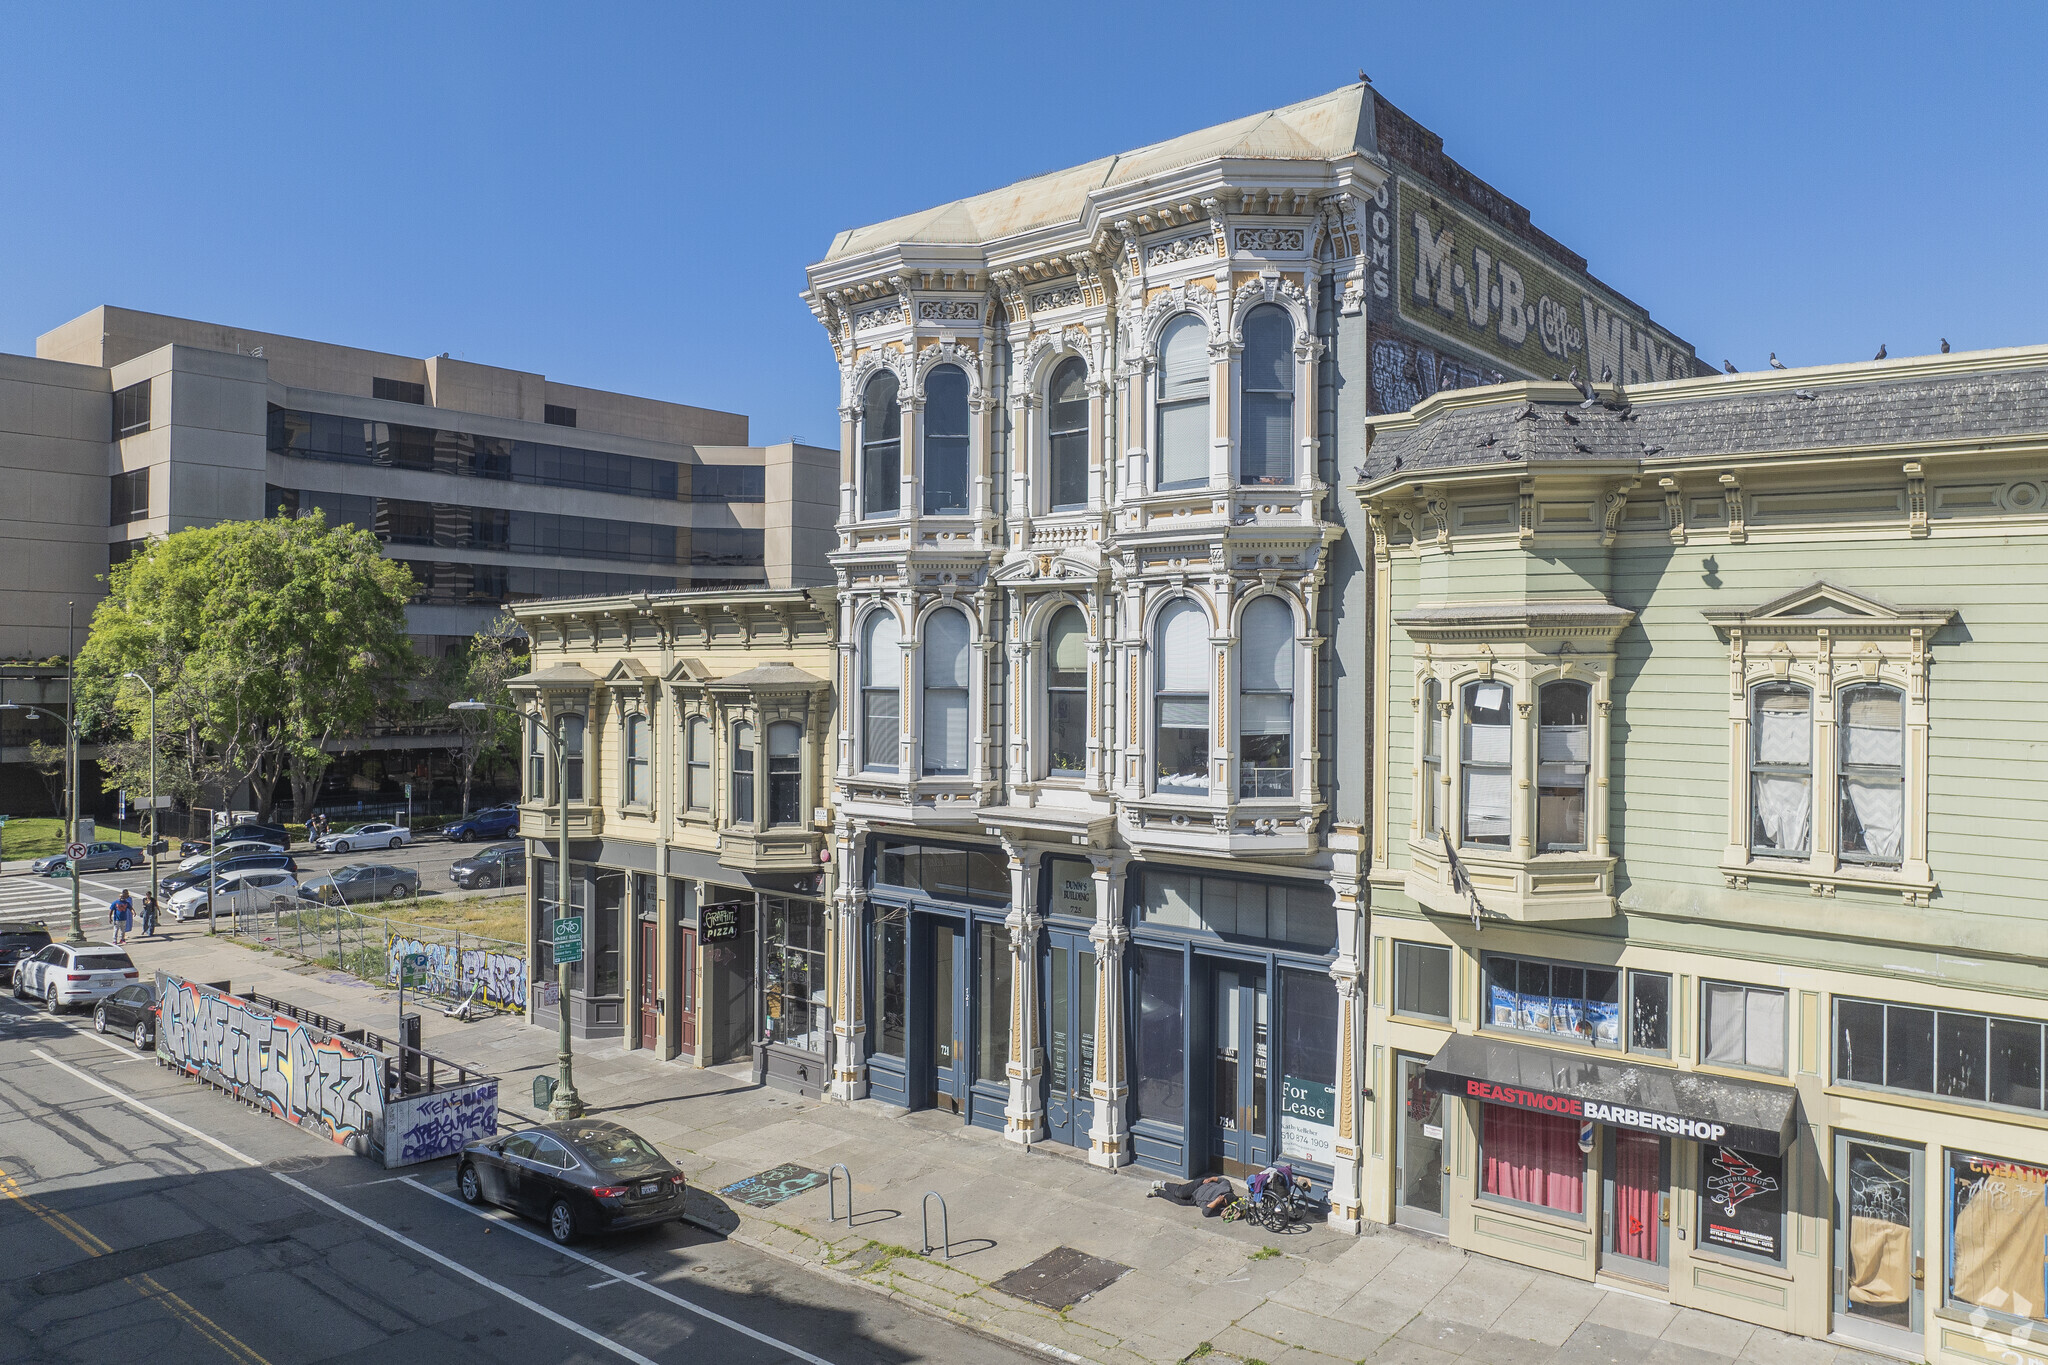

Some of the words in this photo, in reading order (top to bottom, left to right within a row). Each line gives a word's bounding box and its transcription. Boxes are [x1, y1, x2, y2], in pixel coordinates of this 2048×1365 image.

[1539, 295, 1582, 358] Coffee
[1065, 880, 1087, 891] DUNN'S
[1063, 890, 1090, 902] BUILDING
[1070, 905, 1082, 914] 725
[707, 926, 734, 938] PIZZA
[940, 1044, 950, 1057] 721
[291, 1026, 384, 1146] PIZZA
[1082, 1077, 1093, 1086] 725
[1283, 1082, 1308, 1100] For
[1282, 1097, 1325, 1120] Lease
[1467, 1080, 1582, 1116] BEASTMODE
[1584, 1102, 1725, 1141] BARBERSHOP
[1282, 1132, 1295, 1140] 510
[1296, 1134, 1308, 1144] 874
[1311, 1138, 1329, 1149] 1909
[1718, 1176, 1768, 1187] BARBERSHOP
